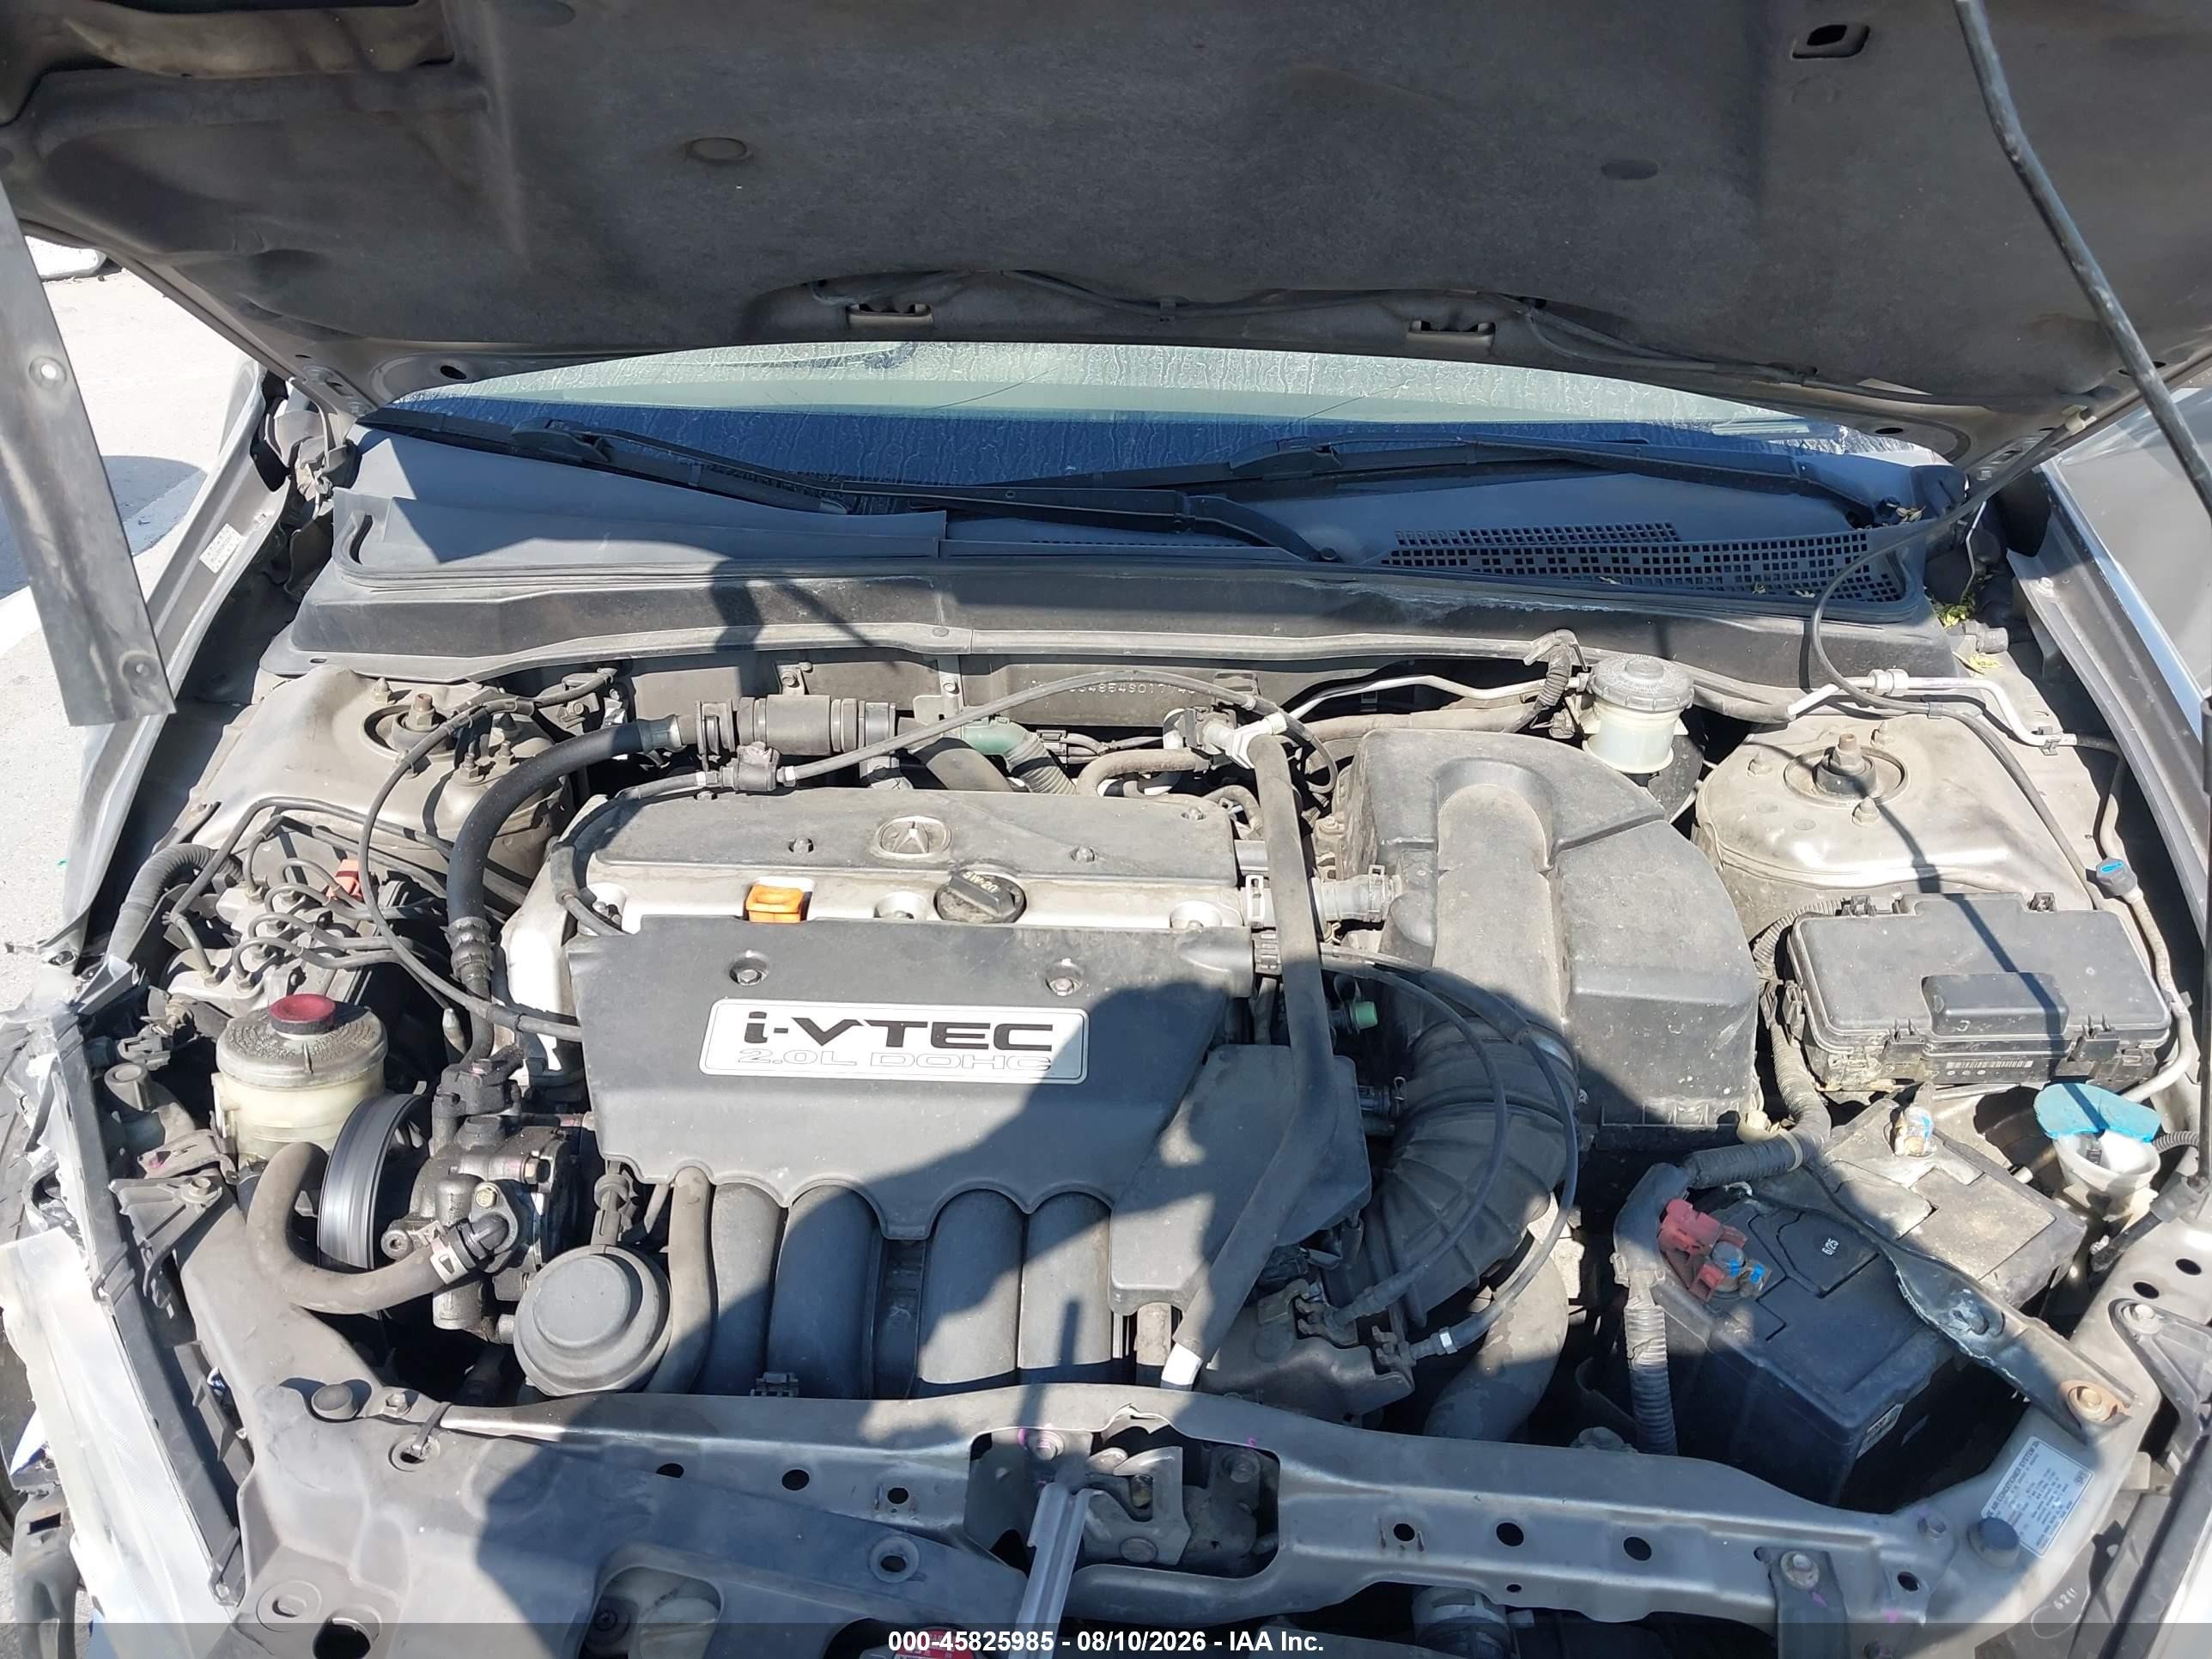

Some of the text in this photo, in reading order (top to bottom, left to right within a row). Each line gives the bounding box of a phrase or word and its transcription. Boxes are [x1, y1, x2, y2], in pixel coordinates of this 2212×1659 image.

[962, 870, 999, 893] 5W-20
[744, 1011, 1054, 1052] i-VTEC
[737, 1048, 1052, 1072] 2.0L DOHC
[1821, 1237, 1839, 1255] 6/25
